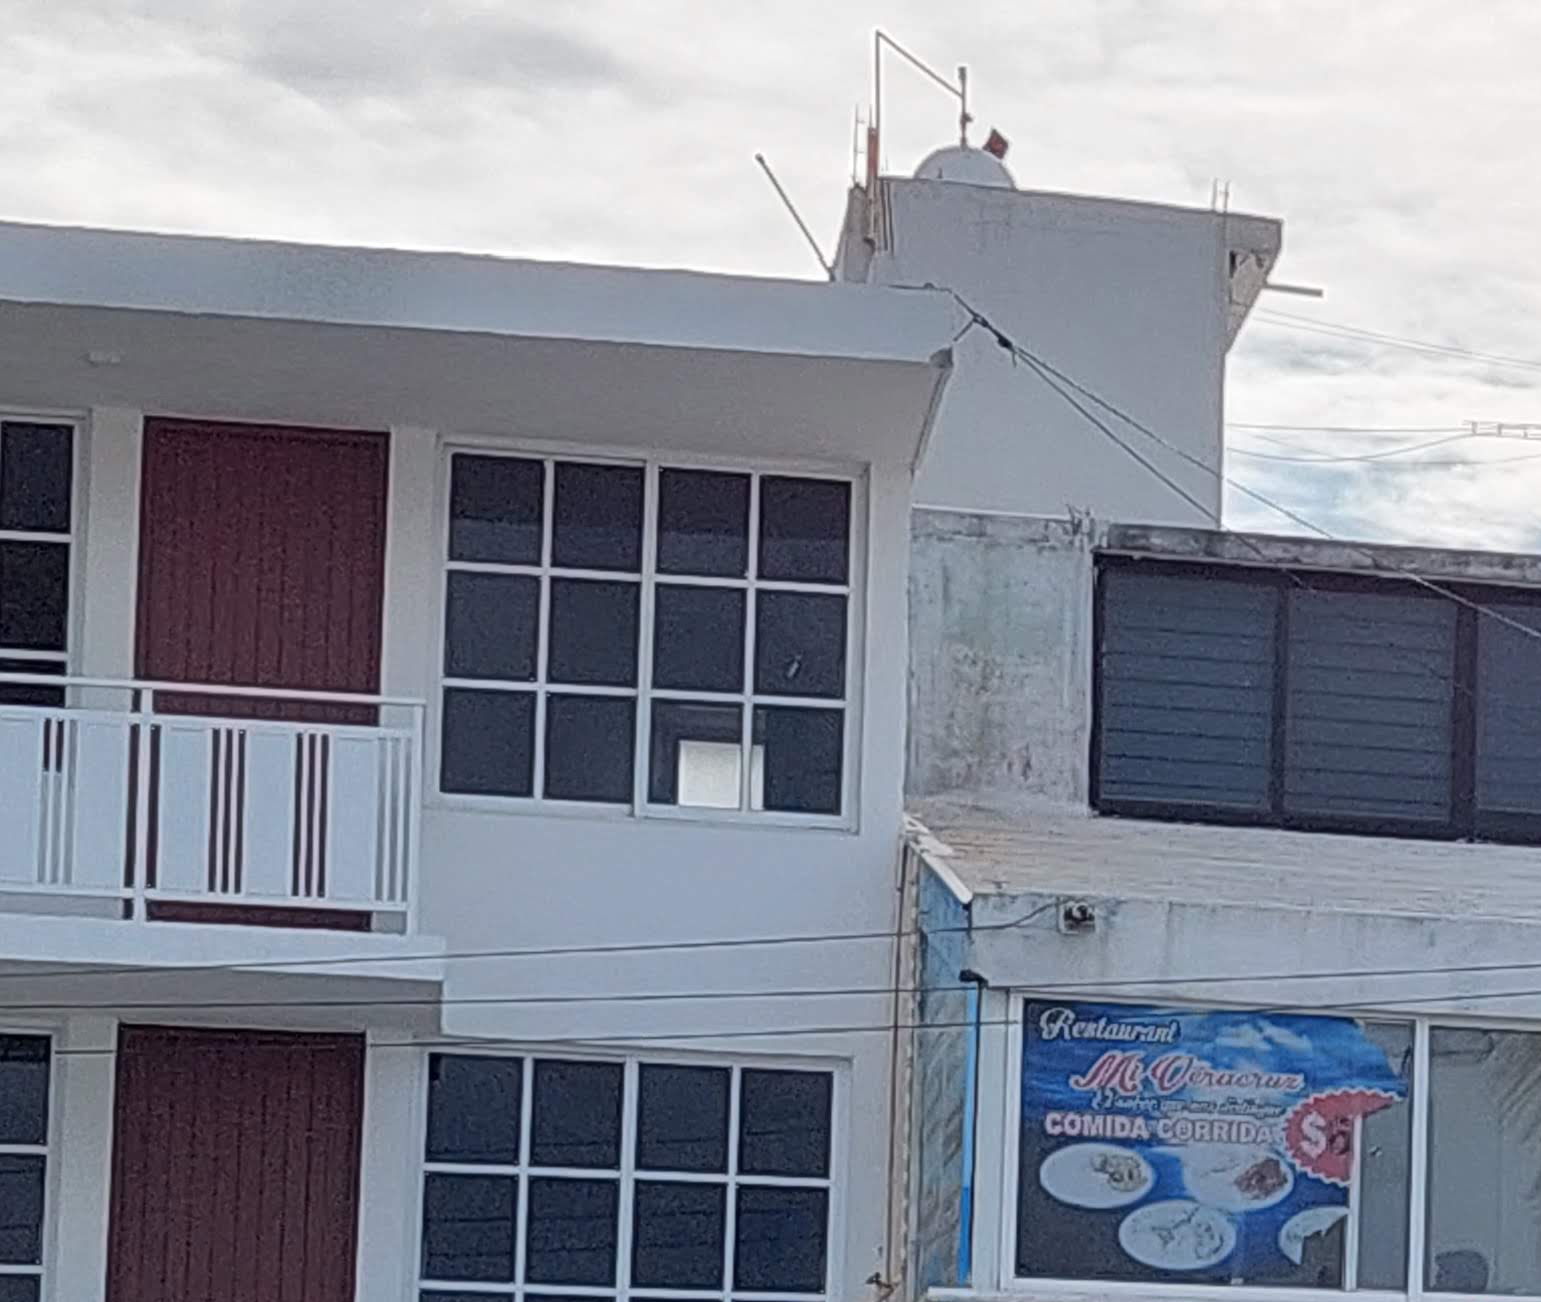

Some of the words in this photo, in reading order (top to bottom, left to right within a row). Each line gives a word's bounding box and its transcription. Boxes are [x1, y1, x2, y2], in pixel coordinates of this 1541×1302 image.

[1040, 1007, 1179, 1042] Restaurant
[1071, 1050, 1142, 1093] Mi
[1150, 1054, 1304, 1094] Veracruz
[1045, 1112, 1149, 1140] COMIDA
[1157, 1117, 1271, 1144] CORRIDA
